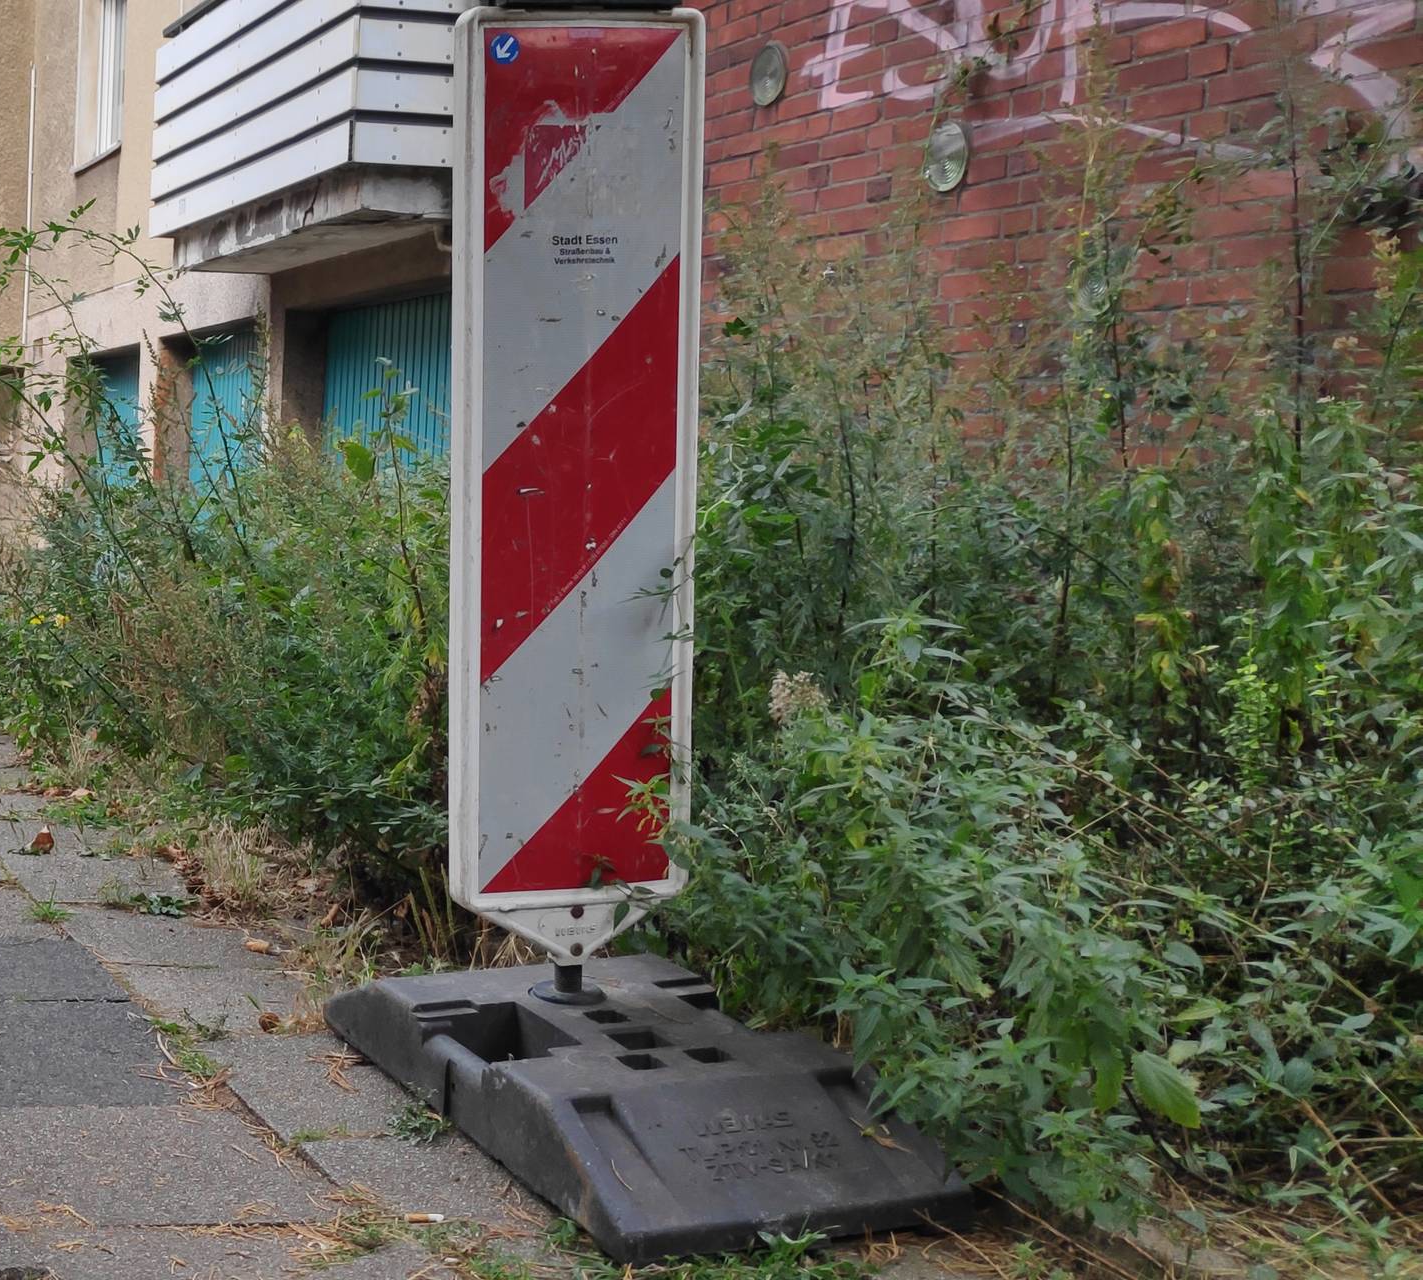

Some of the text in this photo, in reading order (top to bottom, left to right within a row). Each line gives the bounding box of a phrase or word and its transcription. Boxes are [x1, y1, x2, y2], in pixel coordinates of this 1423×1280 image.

[552, 234, 618, 246] Stadt Essen
[559, 247, 611, 256] Straßenbau &
[554, 256, 615, 265] Verkehrstechnik
